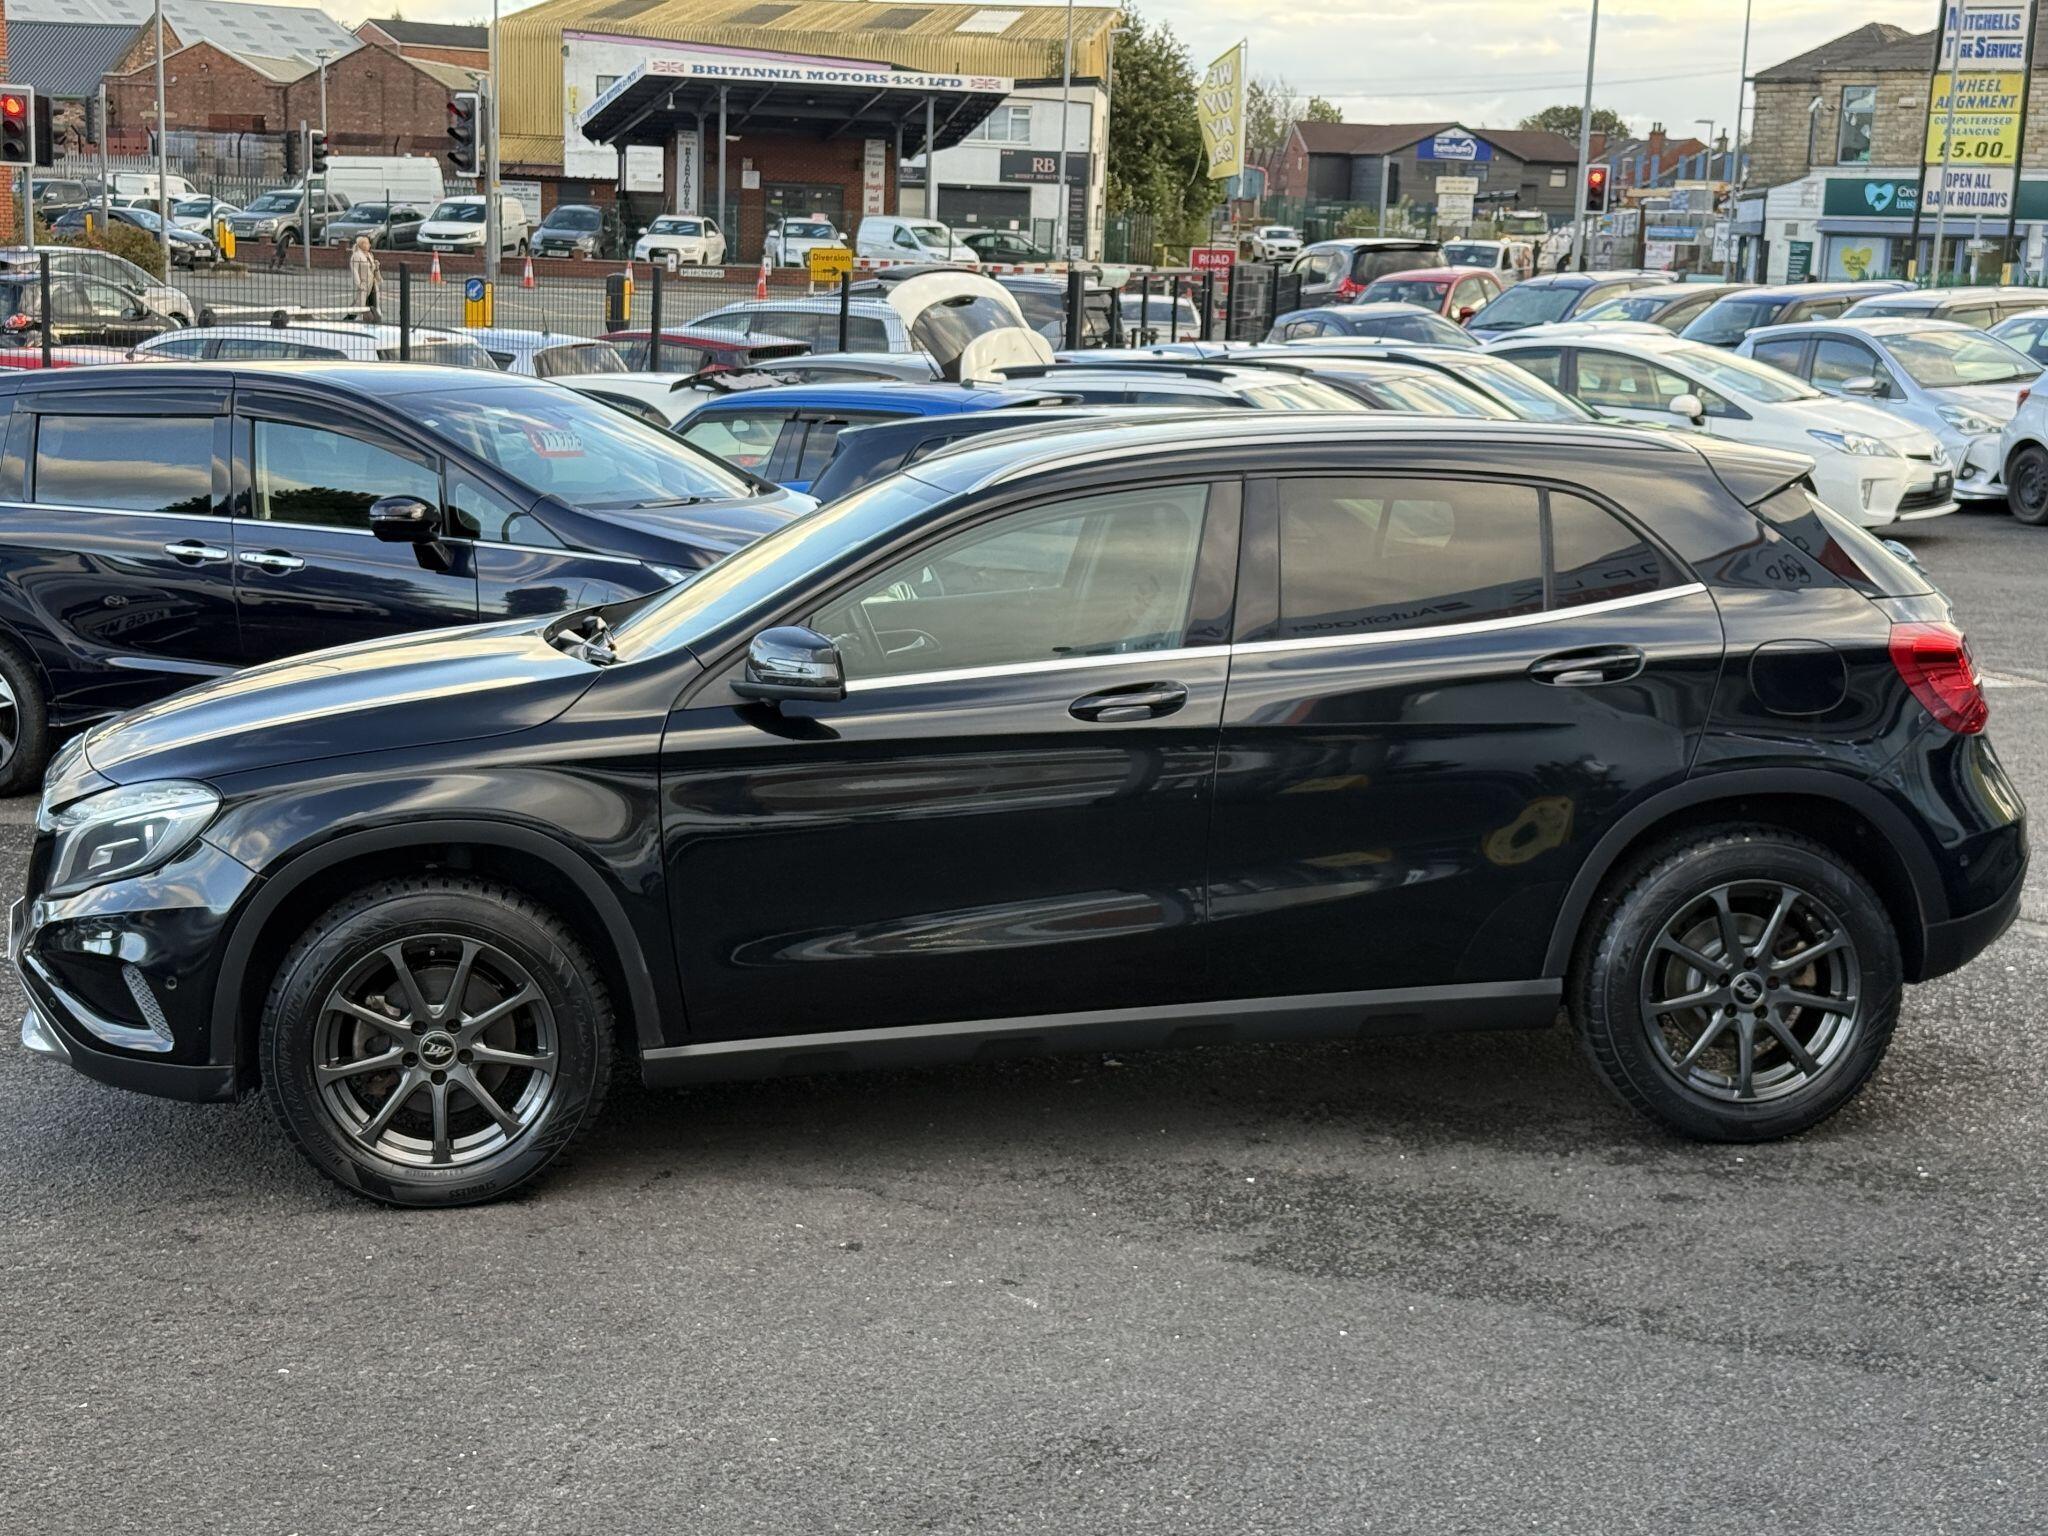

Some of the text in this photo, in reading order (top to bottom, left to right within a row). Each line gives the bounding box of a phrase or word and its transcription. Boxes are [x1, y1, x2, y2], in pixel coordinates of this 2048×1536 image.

[1945, 37, 1973, 58] TRE
[692, 64, 802, 80] BRITANNIA
[806, 70, 888, 84] MOTORS
[928, 77, 963, 88] LTD
[1934, 95, 2018, 109] ALGNMENT
[1032, 157, 1056, 173] RB
[1946, 172, 1991, 189] OPEN ALL
[1957, 191, 2008, 208] HOLIDAYS
[812, 252, 850, 262] Diversion
[1198, 253, 1230, 265] ROAD
